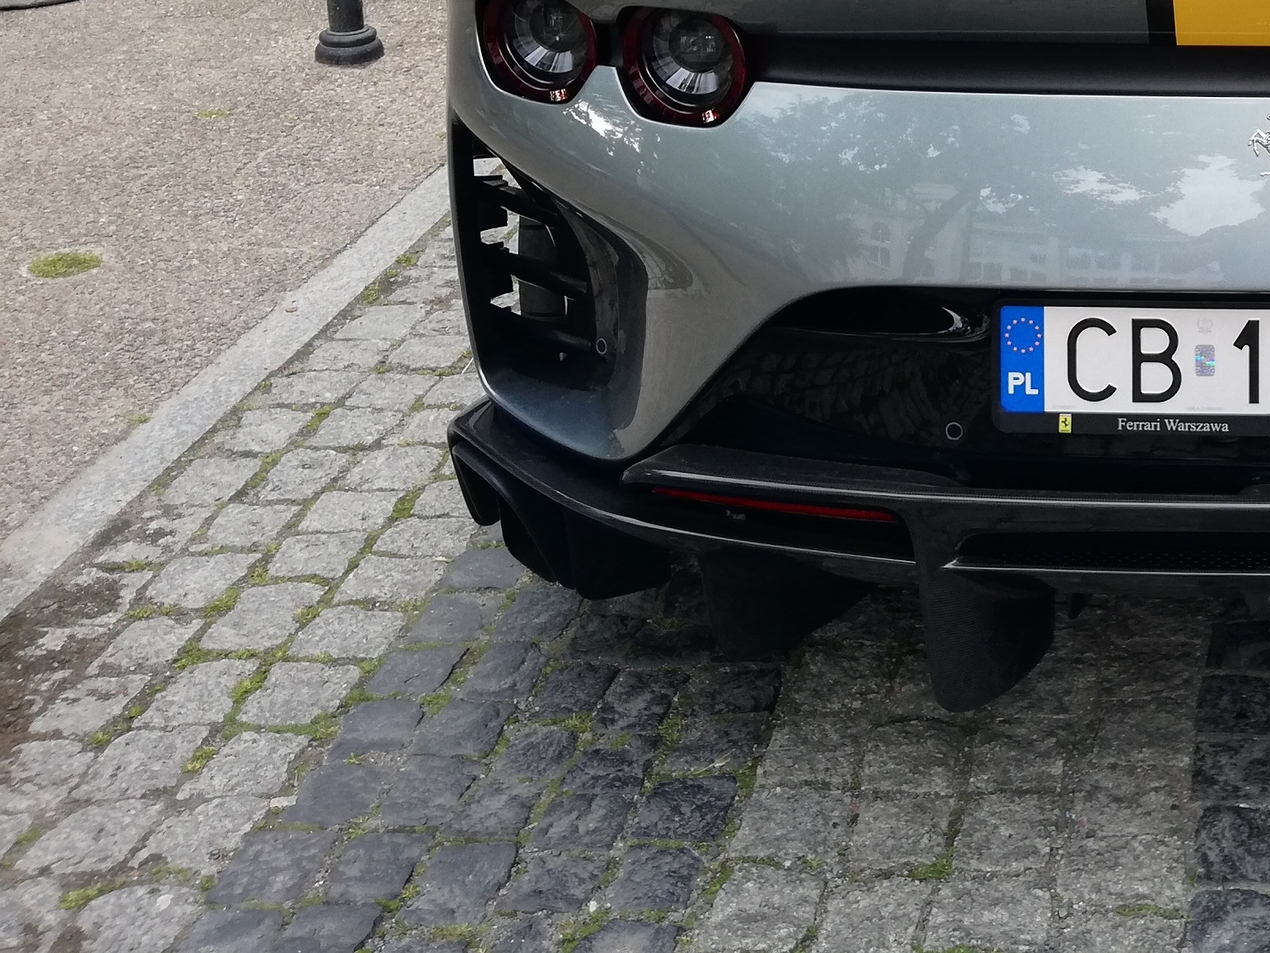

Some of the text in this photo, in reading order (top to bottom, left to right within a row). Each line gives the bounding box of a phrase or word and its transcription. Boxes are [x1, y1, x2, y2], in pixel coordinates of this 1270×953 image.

[1066, 317, 1182, 404] CB
[1007, 371, 1039, 395] PL
[1117, 417, 1230, 432] Ferrari Warszawa
